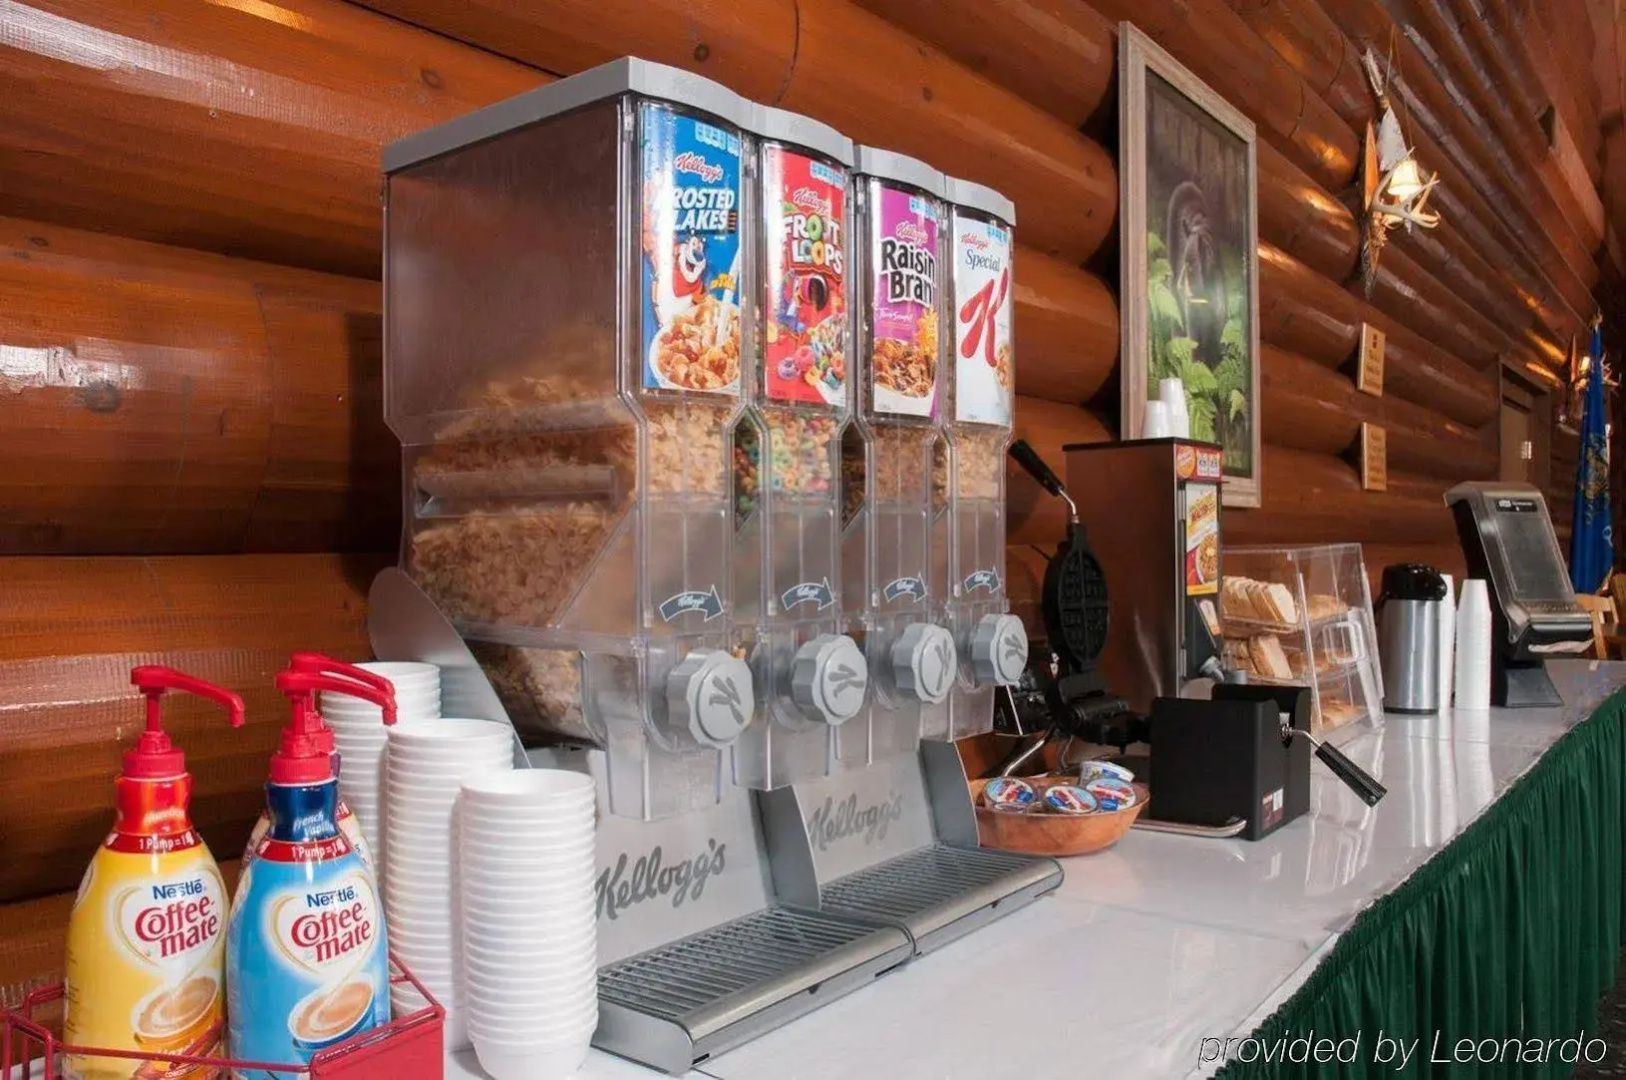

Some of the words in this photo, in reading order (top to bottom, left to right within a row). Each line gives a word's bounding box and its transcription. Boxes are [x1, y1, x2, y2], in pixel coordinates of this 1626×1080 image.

[675, 152, 724, 183] Kellogg's
[657, 187, 736, 210] ROSTED
[659, 209, 729, 231] LAKES
[780, 213, 840, 244] FROT
[791, 239, 843, 275] LOOPS
[880, 240, 936, 284] Raisin
[965, 249, 1001, 272] Special
[889, 270, 933, 304] Bran
[959, 267, 1009, 367] K
[808, 792, 901, 851] Kellogg's
[595, 838, 726, 920] Kellogg's
[160, 914, 217, 957] mate
[315, 919, 371, 962] mate
